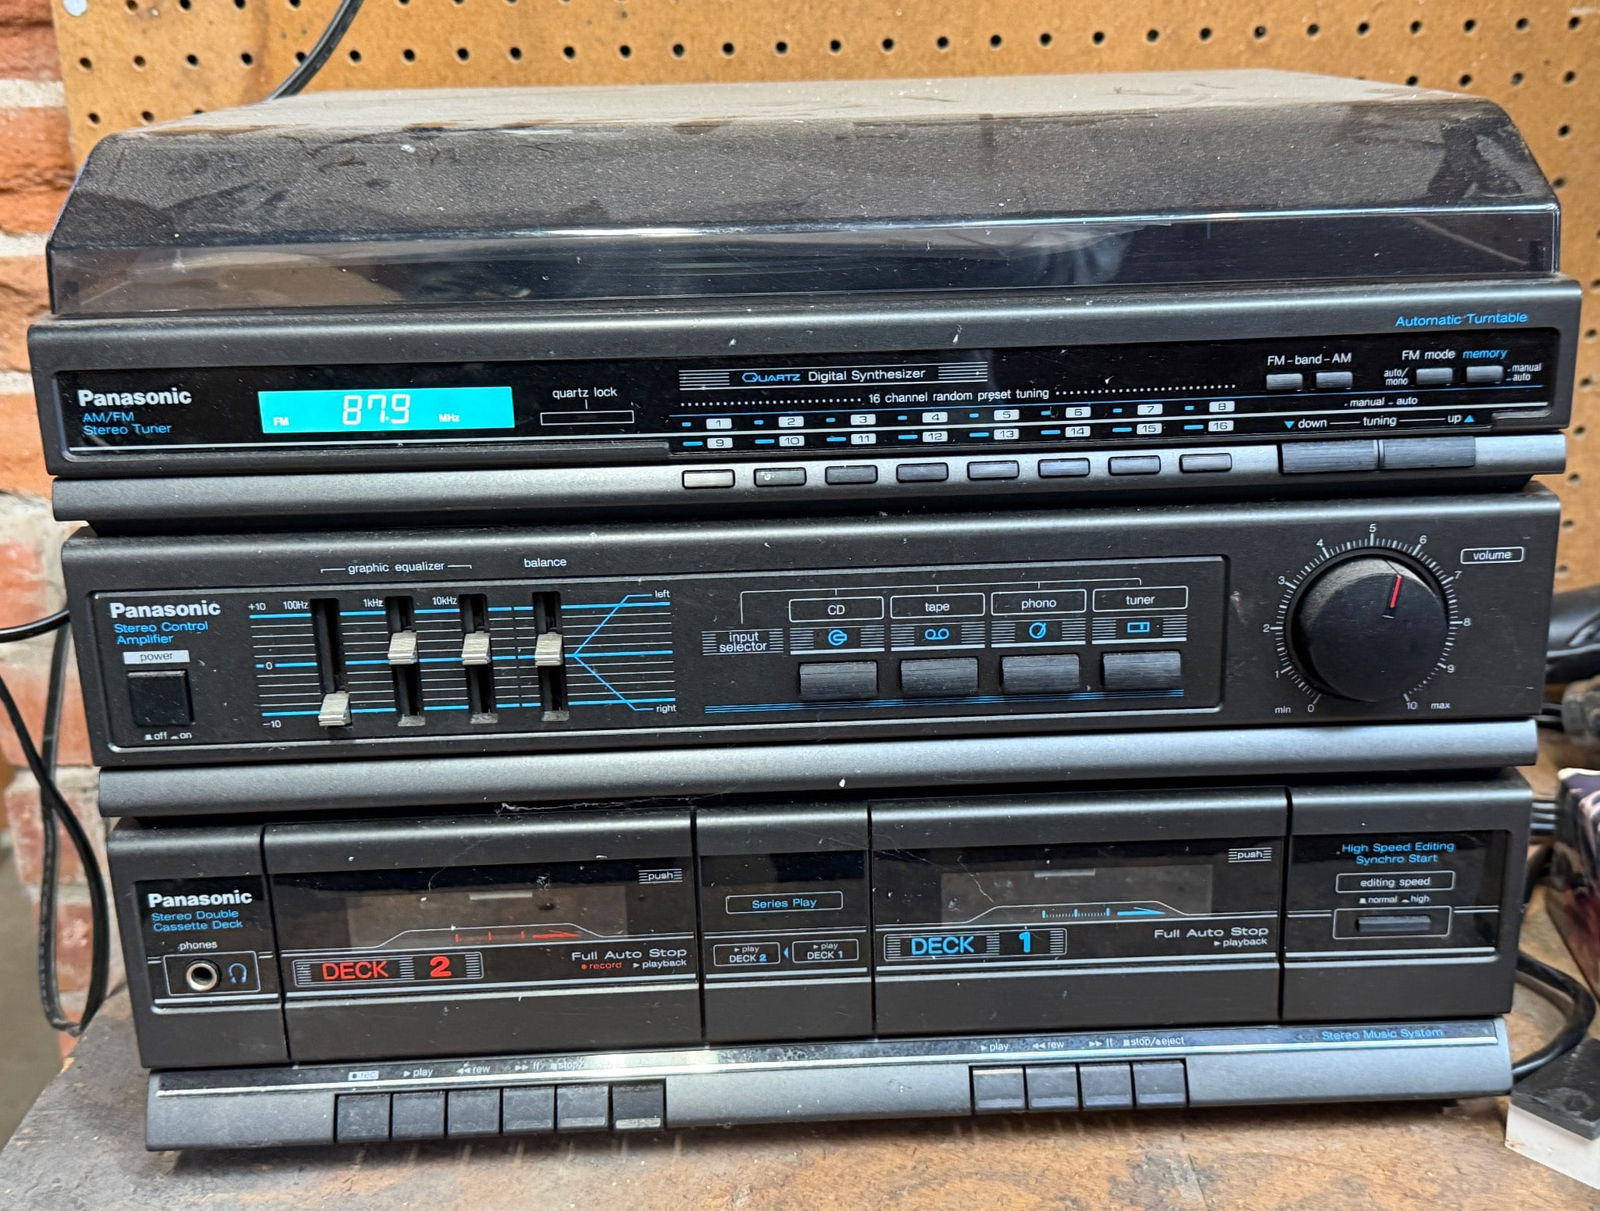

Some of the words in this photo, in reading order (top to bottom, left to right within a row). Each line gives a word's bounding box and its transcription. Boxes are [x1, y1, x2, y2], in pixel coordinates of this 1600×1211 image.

[1395, 315, 1461, 327] Automatic
[1467, 313, 1528, 324] Turntable
[1267, 356, 1286, 366] FM
[1295, 355, 1322, 364] band
[1332, 353, 1352, 363] AM
[1402, 350, 1420, 360] FM
[1425, 349, 1455, 359] mode
[1463, 350, 1508, 361] memory
[1384, 367, 1409, 378] auto/
[1512, 363, 1542, 372] manual
[808, 370, 846, 383] Digital
[851, 368, 926, 381] Synthesizer
[1512, 373, 1531, 382] auto
[1385, 377, 1408, 386] mono
[77, 387, 193, 407] Panasonic
[552, 388, 589, 401] quartz
[594, 386, 618, 398] lock
[869, 394, 881, 404] 16
[885, 392, 928, 403] channel
[933, 391, 973, 402] random
[978, 390, 1011, 402] preset
[1017, 389, 1049, 401] tuning
[1217, 403, 1227, 411] 8
[1349, 397, 1385, 408] manual
[1396, 396, 1418, 406] auto
[342, 393, 411, 426] 87.9
[1074, 408, 1083, 417] 6
[1147, 406, 1155, 414] 7
[82, 412, 135, 424] AM/FM
[438, 414, 461, 424] MHz
[859, 415, 868, 424] 3
[931, 413, 940, 422] 4
[1003, 411, 1011, 419] 5
[273, 417, 290, 428] FM
[715, 419, 723, 428] 1
[787, 417, 796, 426] 2
[1213, 422, 1228, 430] 16
[1298, 418, 1328, 429] down
[1363, 416, 1397, 428] tuning
[1447, 414, 1462, 425] up
[82, 425, 129, 437] Stereo
[133, 424, 173, 435] Tuner
[1000, 430, 1015, 438] 13
[1070, 427, 1085, 436] 14
[1142, 425, 1157, 433] 15
[783, 437, 800, 445] 10
[857, 435, 871, 443] 11
[928, 432, 943, 441] 12
[715, 439, 725, 447] 9
[1369, 524, 1377, 533] 5
[1316, 538, 1324, 547] 4
[1420, 535, 1428, 544] 6
[1473, 550, 1512, 560] volume
[524, 557, 567, 568] balance
[348, 563, 389, 575] graphic
[394, 561, 445, 573] equalizer
[1278, 576, 1286, 585] 3
[1454, 571, 1463, 580] 7
[654, 589, 670, 599] left
[283, 601, 309, 610] 100Hz
[363, 598, 383, 607] 1kHz
[432, 596, 457, 606] 10kHz
[1022, 598, 1057, 610] phono
[1126, 595, 1156, 606] tuner
[110, 600, 222, 618] Panasonic
[248, 602, 266, 611] +10
[827, 604, 846, 615] CD
[925, 602, 950, 613] tape
[114, 623, 158, 633] Stereo
[161, 621, 209, 632] Control
[1463, 618, 1472, 627] 8
[1263, 624, 1271, 633] 2
[116, 634, 174, 646] Amplifier
[729, 632, 759, 643] input
[719, 640, 768, 652] selector
[140, 652, 174, 662] power
[265, 662, 273, 670] 0
[1447, 665, 1455, 674] 9
[1274, 671, 1280, 679] 1
[656, 703, 677, 714] right
[1275, 705, 1292, 714] min
[1307, 704, 1315, 713] 0
[1406, 701, 1418, 711] 10
[1431, 702, 1451, 710] max
[262, 720, 281, 728] -10
[153, 731, 168, 740] off
[180, 732, 192, 740] on
[1342, 844, 1369, 855] High
[1373, 843, 1411, 854] Speed
[1415, 842, 1455, 853] Editing
[1237, 850, 1263, 860] push
[1356, 855, 1405, 866] Synchro
[1408, 853, 1438, 863] Start
[648, 871, 674, 881] push
[1360, 877, 1395, 888] editing
[1399, 876, 1431, 888] speed
[147, 889, 253, 908] Panasonic
[1368, 896, 1398, 904] normal
[1410, 895, 1430, 904] high
[752, 899, 789, 910] Series
[793, 898, 817, 909] Play
[152, 912, 192, 922] Stereo
[196, 910, 239, 920] Double
[153, 921, 208, 932] Cassette
[212, 920, 244, 930] Deck
[1154, 929, 1180, 939] Full
[1186, 928, 1224, 938] Auto
[1231, 926, 1269, 938] Stop
[179, 941, 218, 952] phones
[821, 942, 839, 952] play
[911, 935, 974, 955] DECK
[1018, 931, 1031, 953] 1
[1223, 937, 1268, 948] playback
[572, 951, 597, 961] Full
[604, 950, 642, 960] Auto
[649, 948, 687, 960] Stop
[742, 945, 760, 954] play
[729, 954, 757, 963] DECK
[759, 953, 767, 962] 2
[807, 951, 835, 960] DECK
[838, 950, 844, 959] 1
[322, 961, 389, 980] DECK
[429, 956, 452, 978] 2
[589, 961, 622, 971] record
[642, 959, 687, 970] playback
[1322, 1031, 1359, 1041] Stereo
[1363, 1029, 1397, 1039] Music
[1401, 1028, 1444, 1039] System
[990, 1042, 1009, 1053] play
[1047, 1040, 1065, 1049] rew
[413, 1067, 434, 1079] play
[473, 1064, 491, 1074] rew
